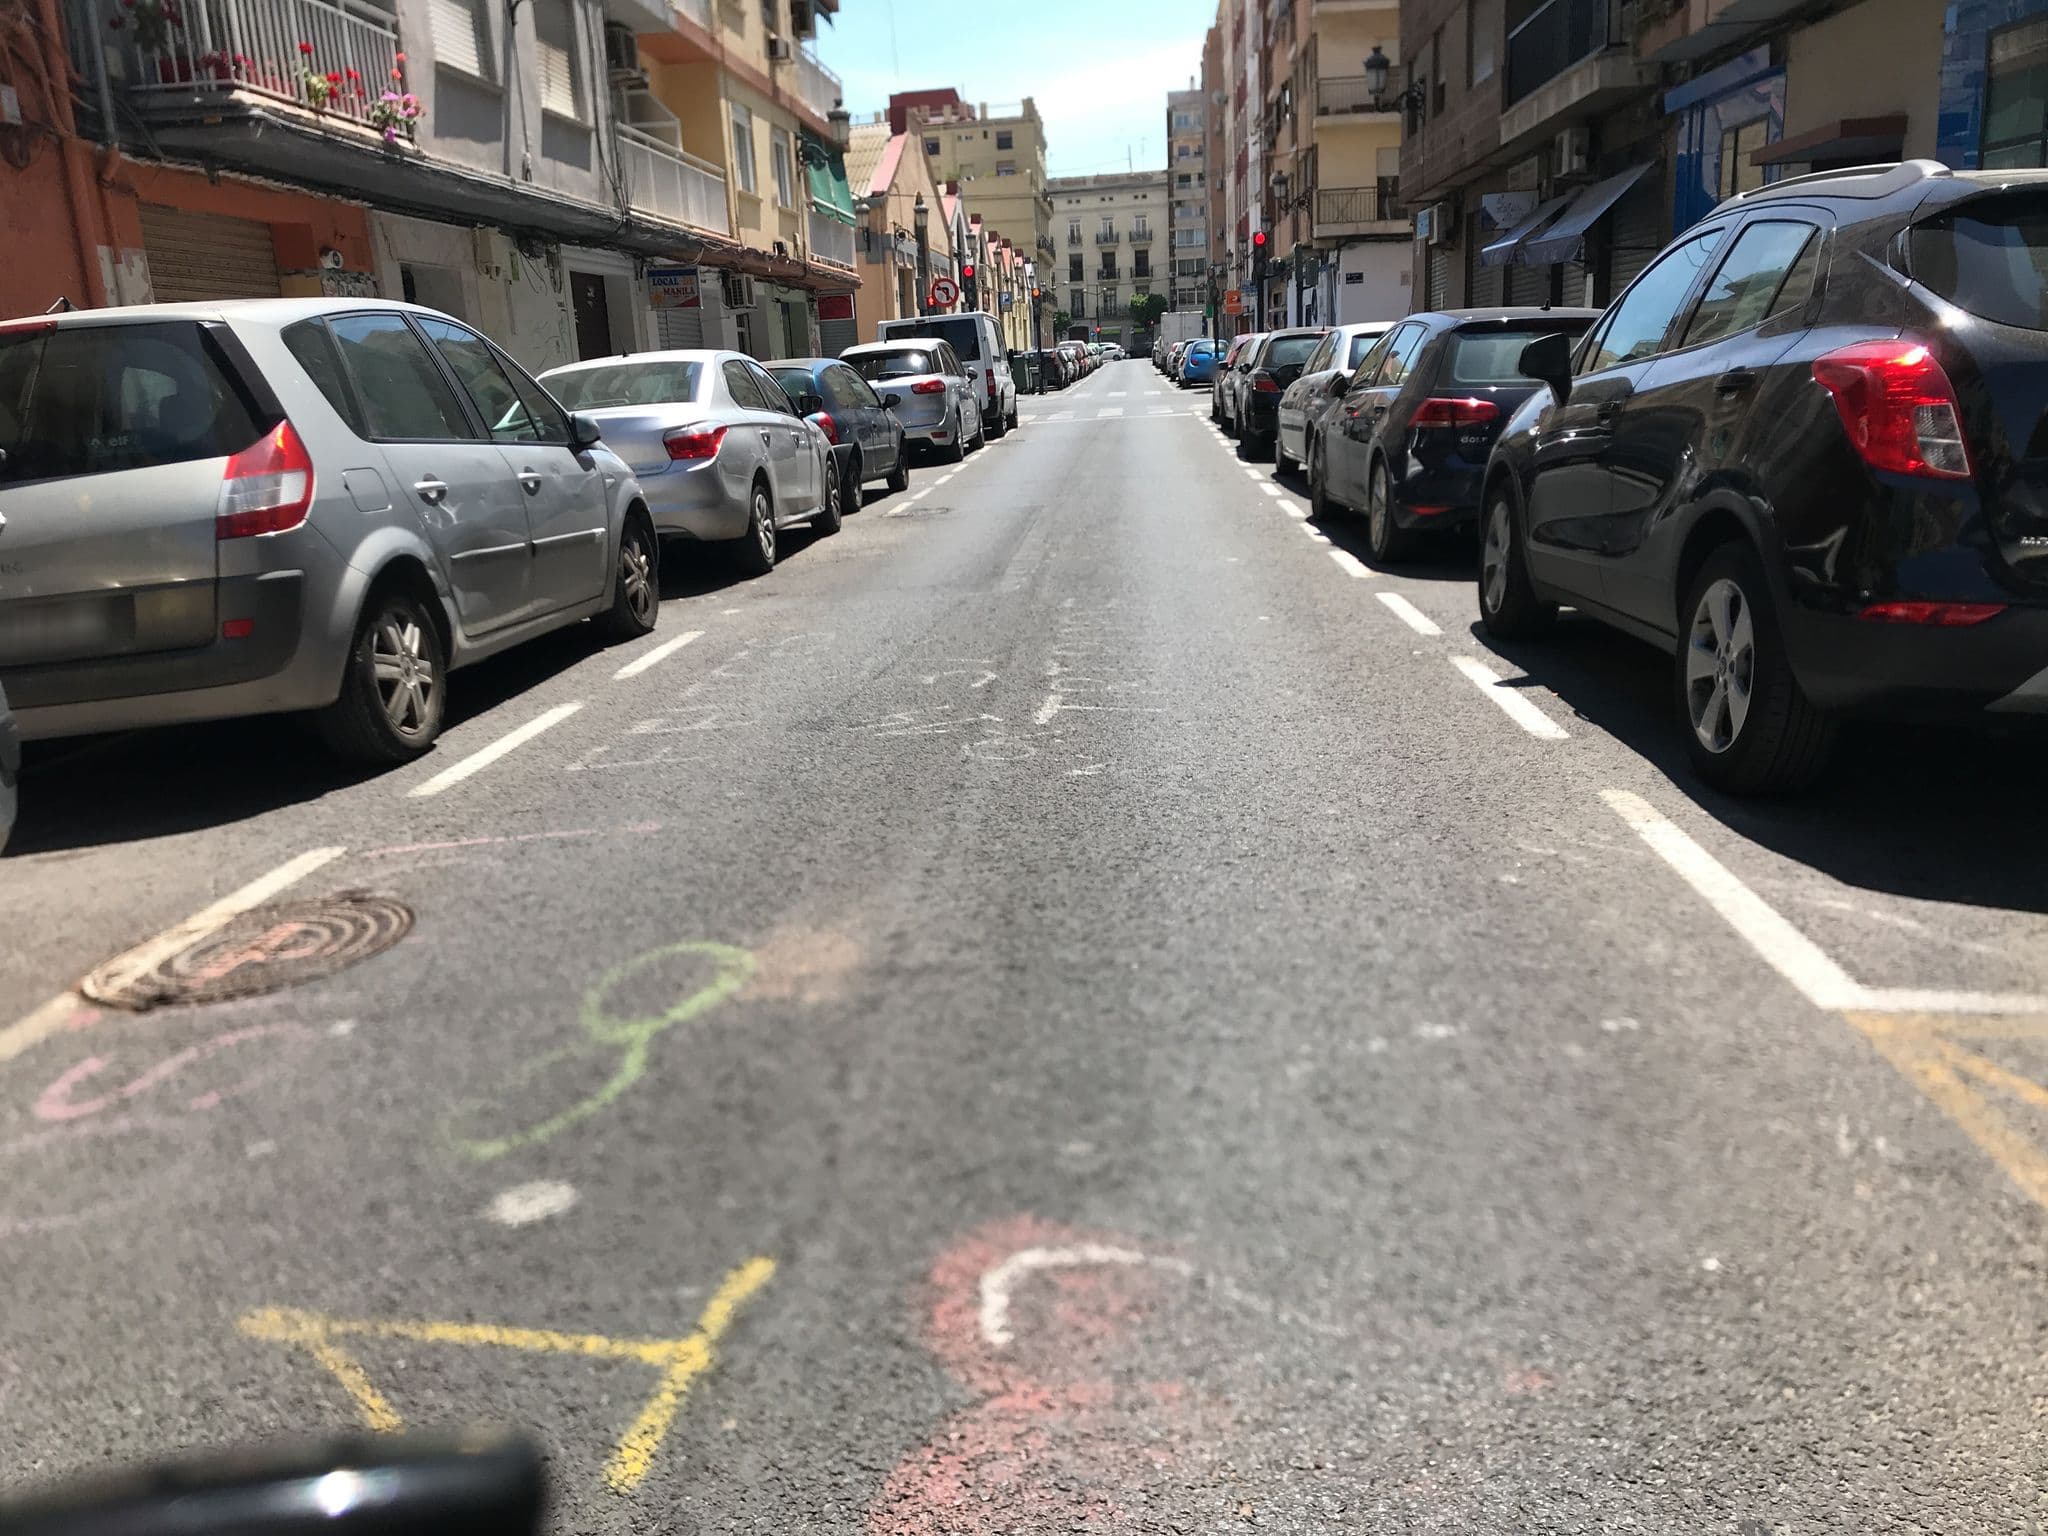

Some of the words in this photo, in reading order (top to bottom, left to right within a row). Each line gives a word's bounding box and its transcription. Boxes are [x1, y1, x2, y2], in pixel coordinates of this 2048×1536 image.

[652, 277, 679, 286] LOCAL
[663, 286, 695, 296] MANILA
[1002, 293, 1009, 302] P
